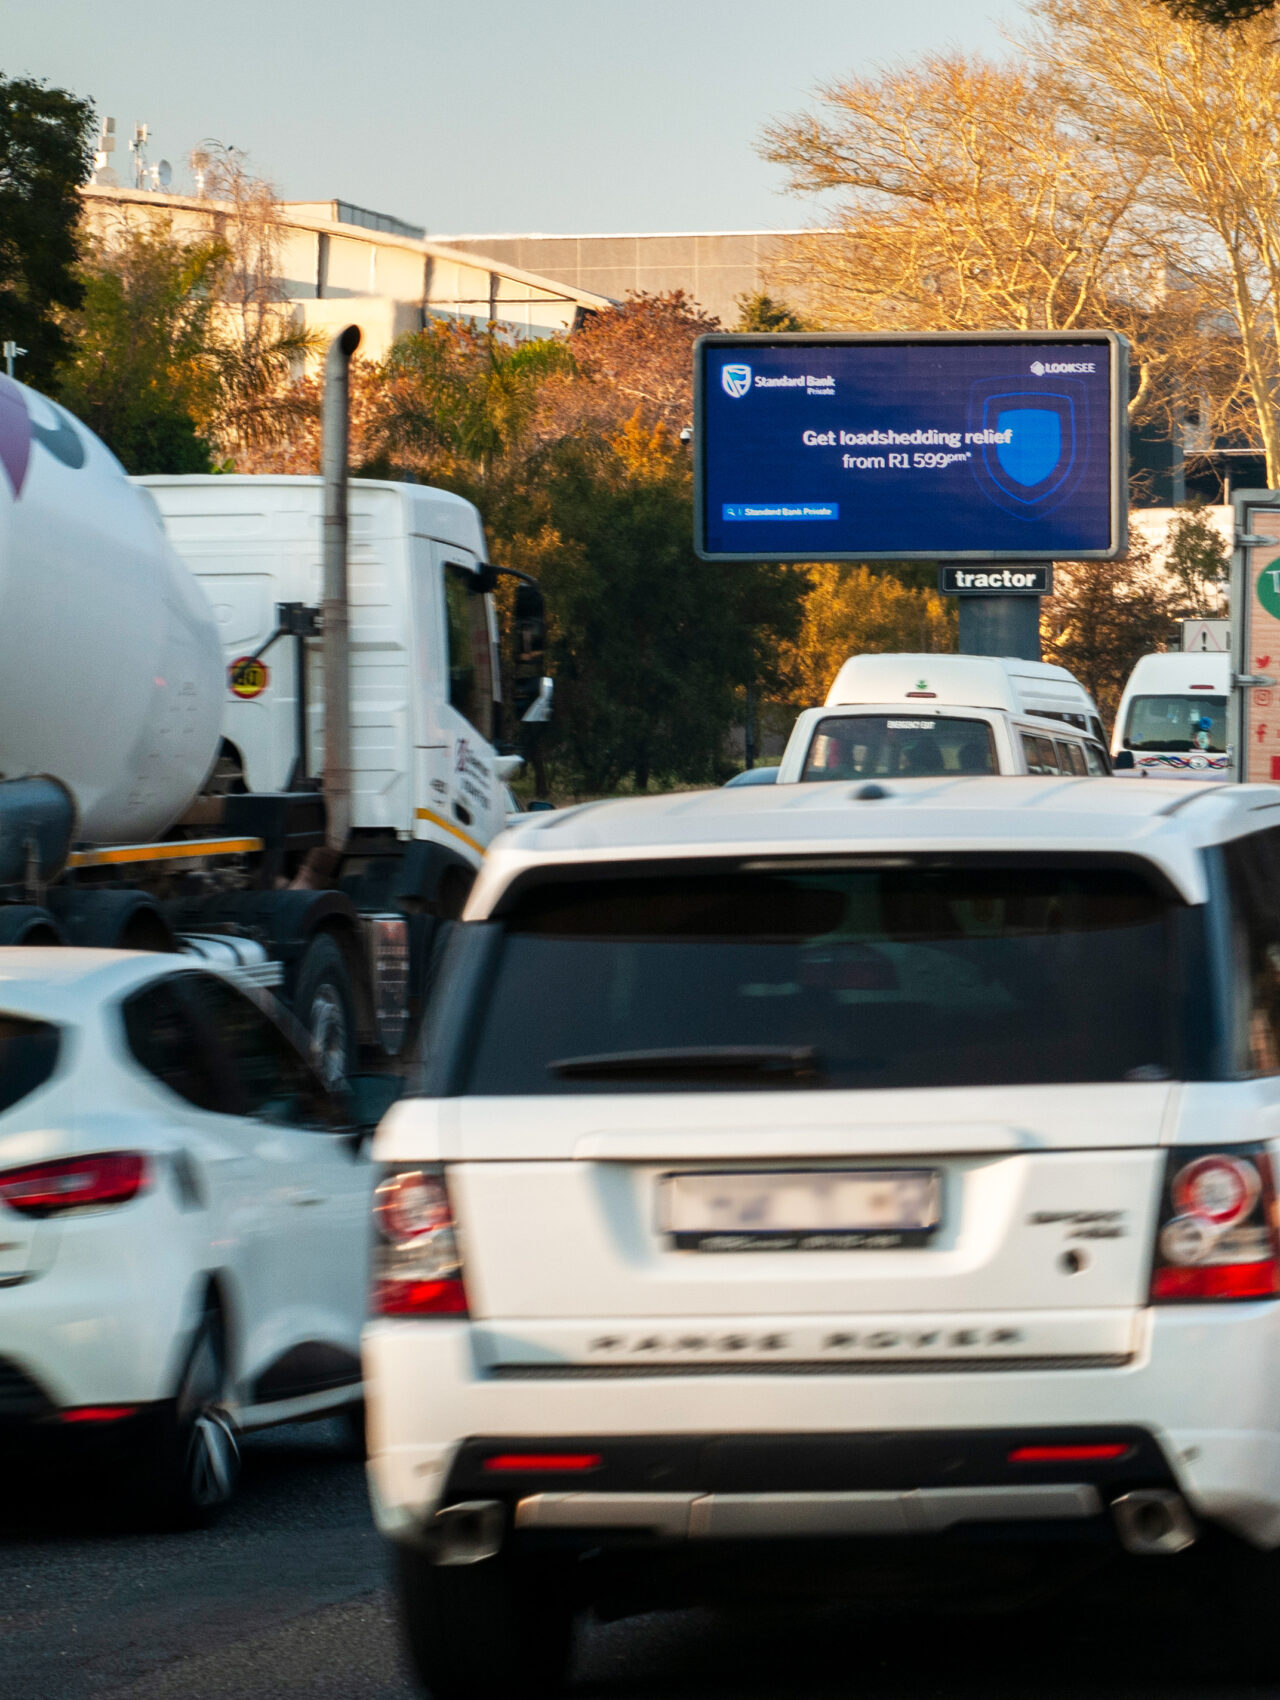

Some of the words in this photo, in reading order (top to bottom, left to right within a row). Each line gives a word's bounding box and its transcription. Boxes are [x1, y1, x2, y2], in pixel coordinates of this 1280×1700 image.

[1045, 363, 1096, 374] LOOKSEE
[754, 375, 806, 388] Standard
[806, 375, 836, 387] Bank
[802, 430, 837, 446] Get
[839, 429, 962, 448] loadshedding
[964, 429, 1013, 445] relief
[842, 453, 885, 469] from
[888, 453, 911, 469] R1
[954, 569, 1037, 588] tractor
[588, 1332, 794, 1353] RANGE
[820, 1327, 1026, 1352] ROVER
